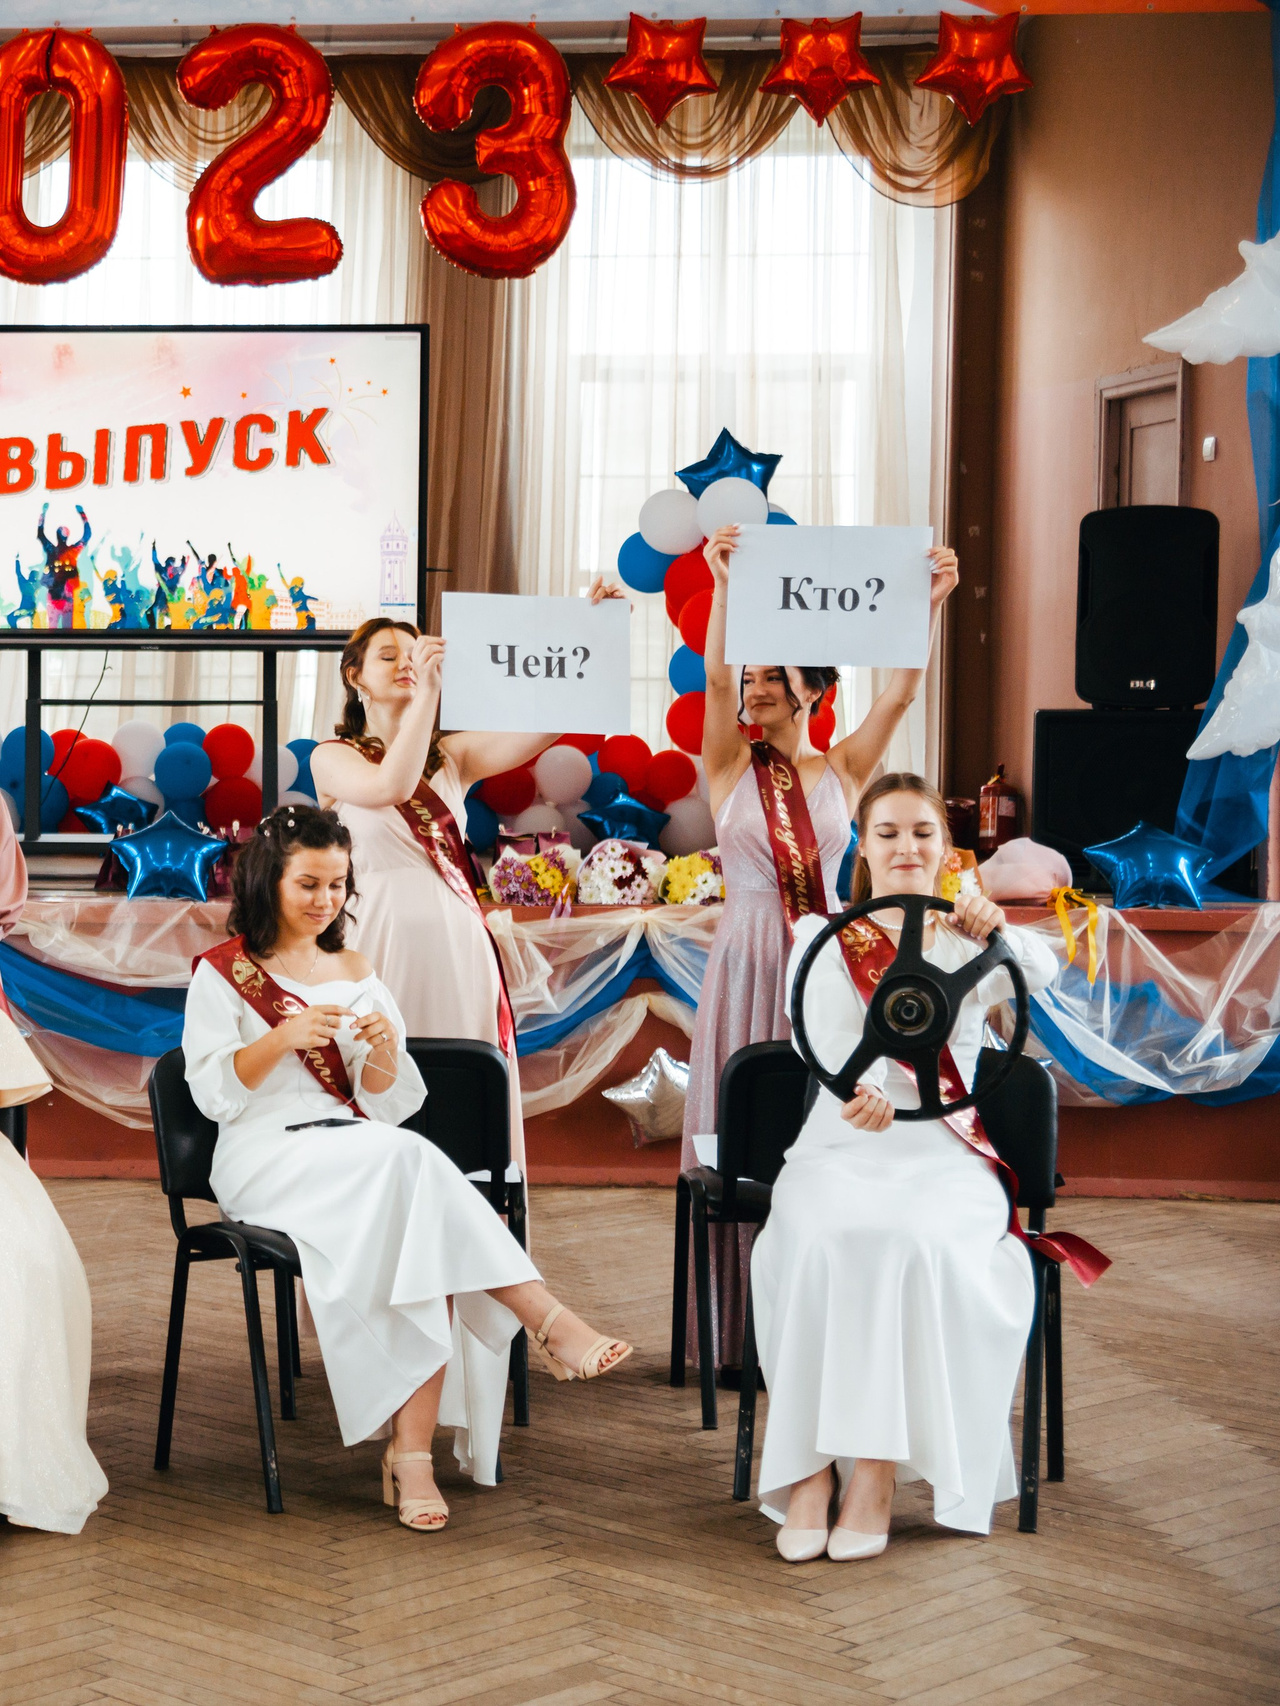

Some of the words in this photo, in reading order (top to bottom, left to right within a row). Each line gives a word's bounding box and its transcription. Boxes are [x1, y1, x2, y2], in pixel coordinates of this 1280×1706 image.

[777, 576, 886, 613] Кто?
[486, 643, 591, 680] Чей?
[768, 760, 810, 916] Выпускни
